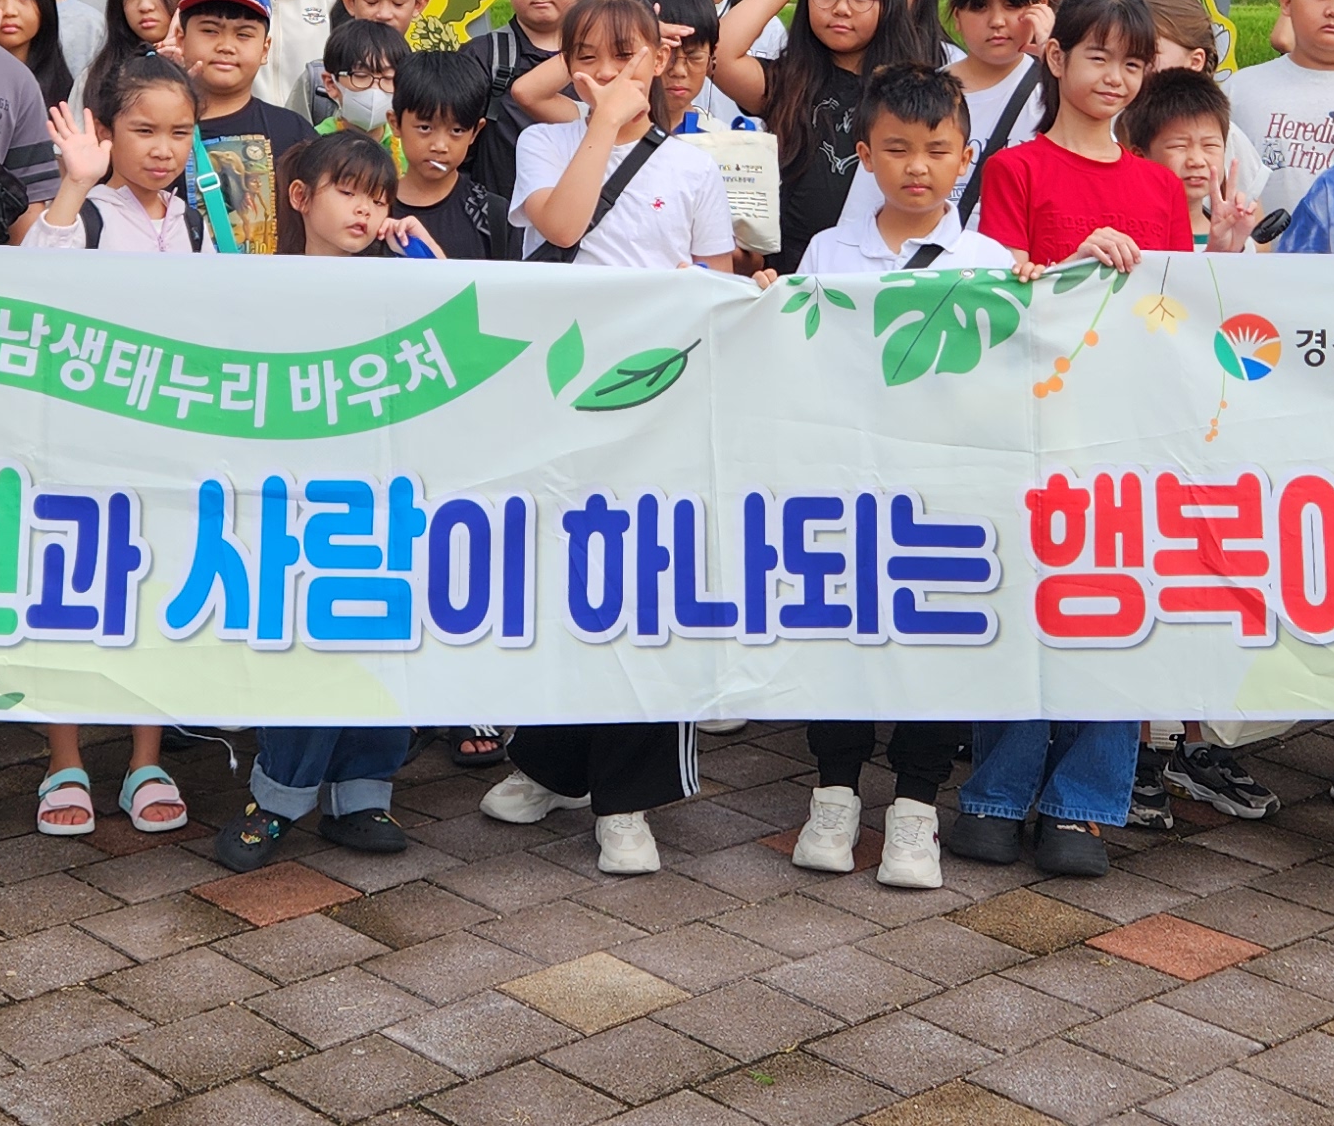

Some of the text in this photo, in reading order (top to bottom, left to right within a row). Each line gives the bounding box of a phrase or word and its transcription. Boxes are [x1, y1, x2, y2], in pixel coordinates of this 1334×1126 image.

[1288, 142, 1326, 175] Trip
[290, 328, 458, 426] 바우처
[167, 474, 527, 642] 사람이
[562, 490, 990, 638] 하나되는
